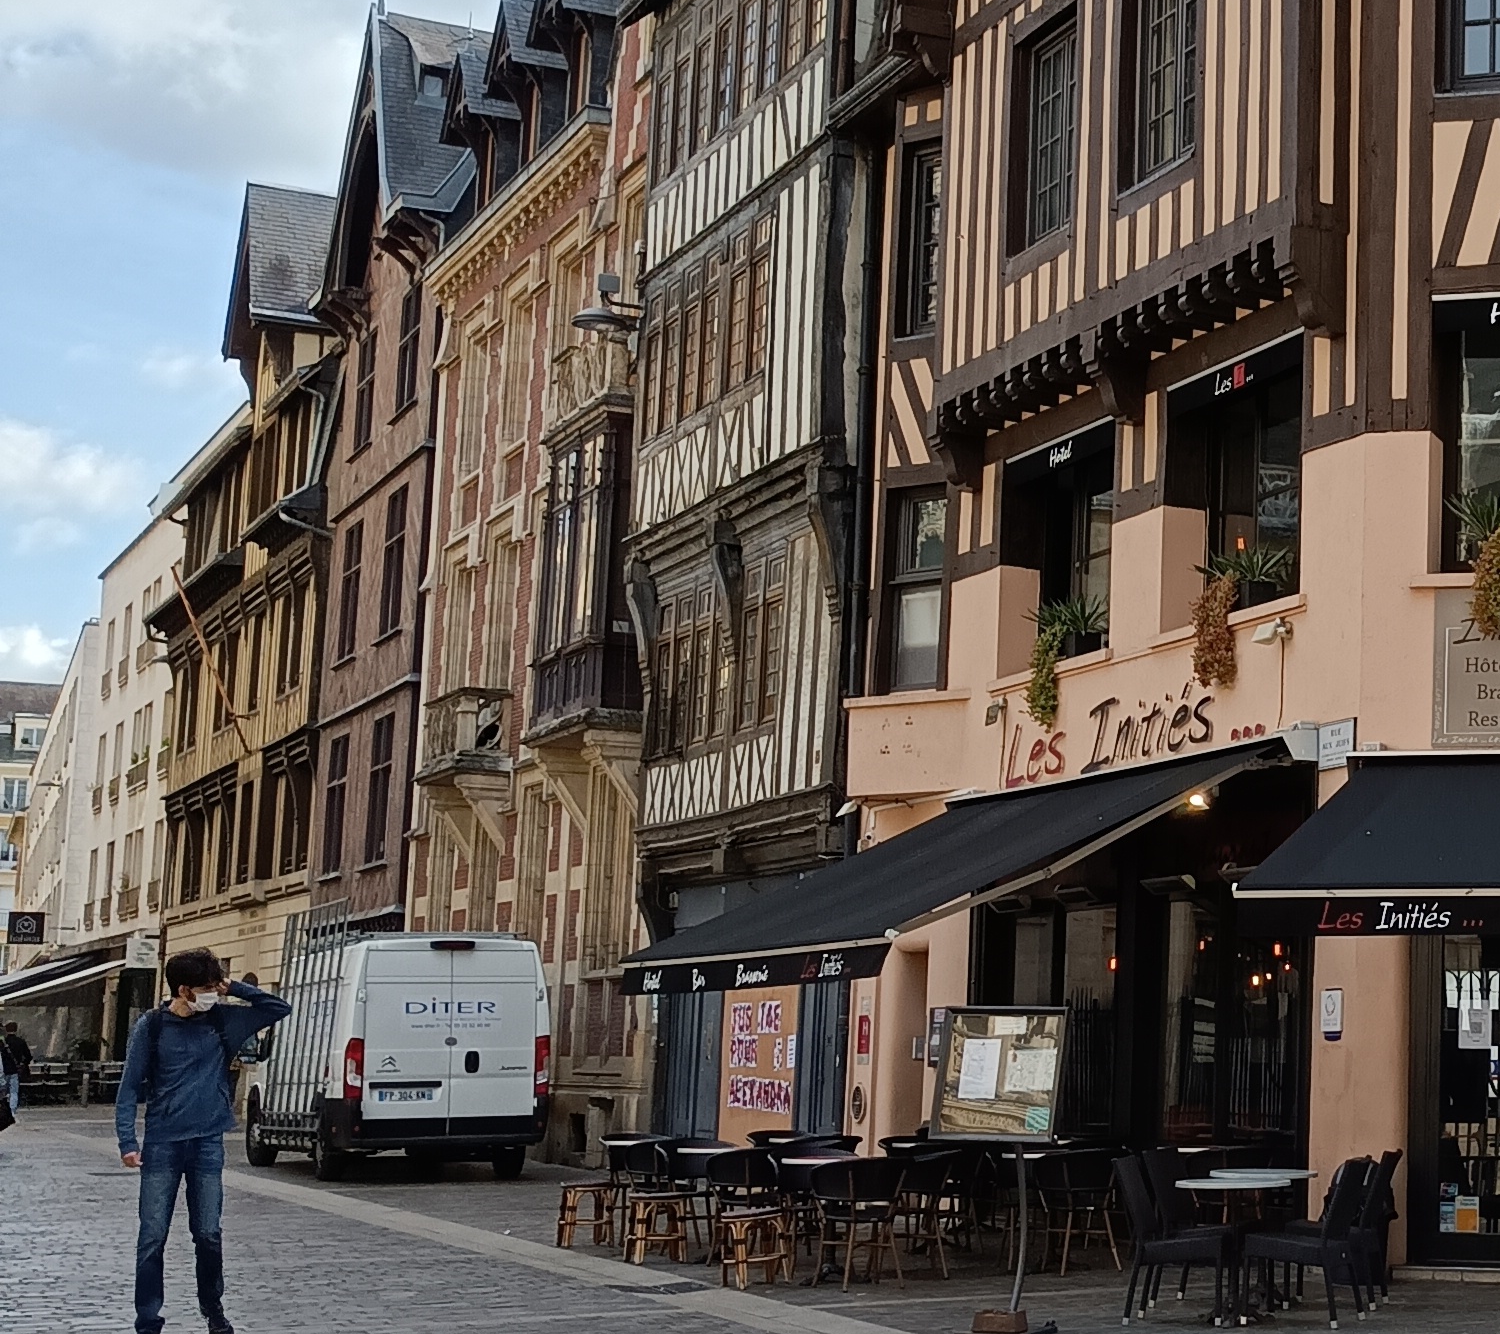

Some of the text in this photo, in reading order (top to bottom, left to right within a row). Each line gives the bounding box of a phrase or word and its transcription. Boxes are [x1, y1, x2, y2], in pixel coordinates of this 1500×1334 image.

[1214, 373, 1232, 396] Les
[1049, 440, 1073, 468] Hotel
[1005, 723, 1067, 790] Les
[1317, 900, 1364, 929] Les
[1375, 901, 1452, 930] Initiés
